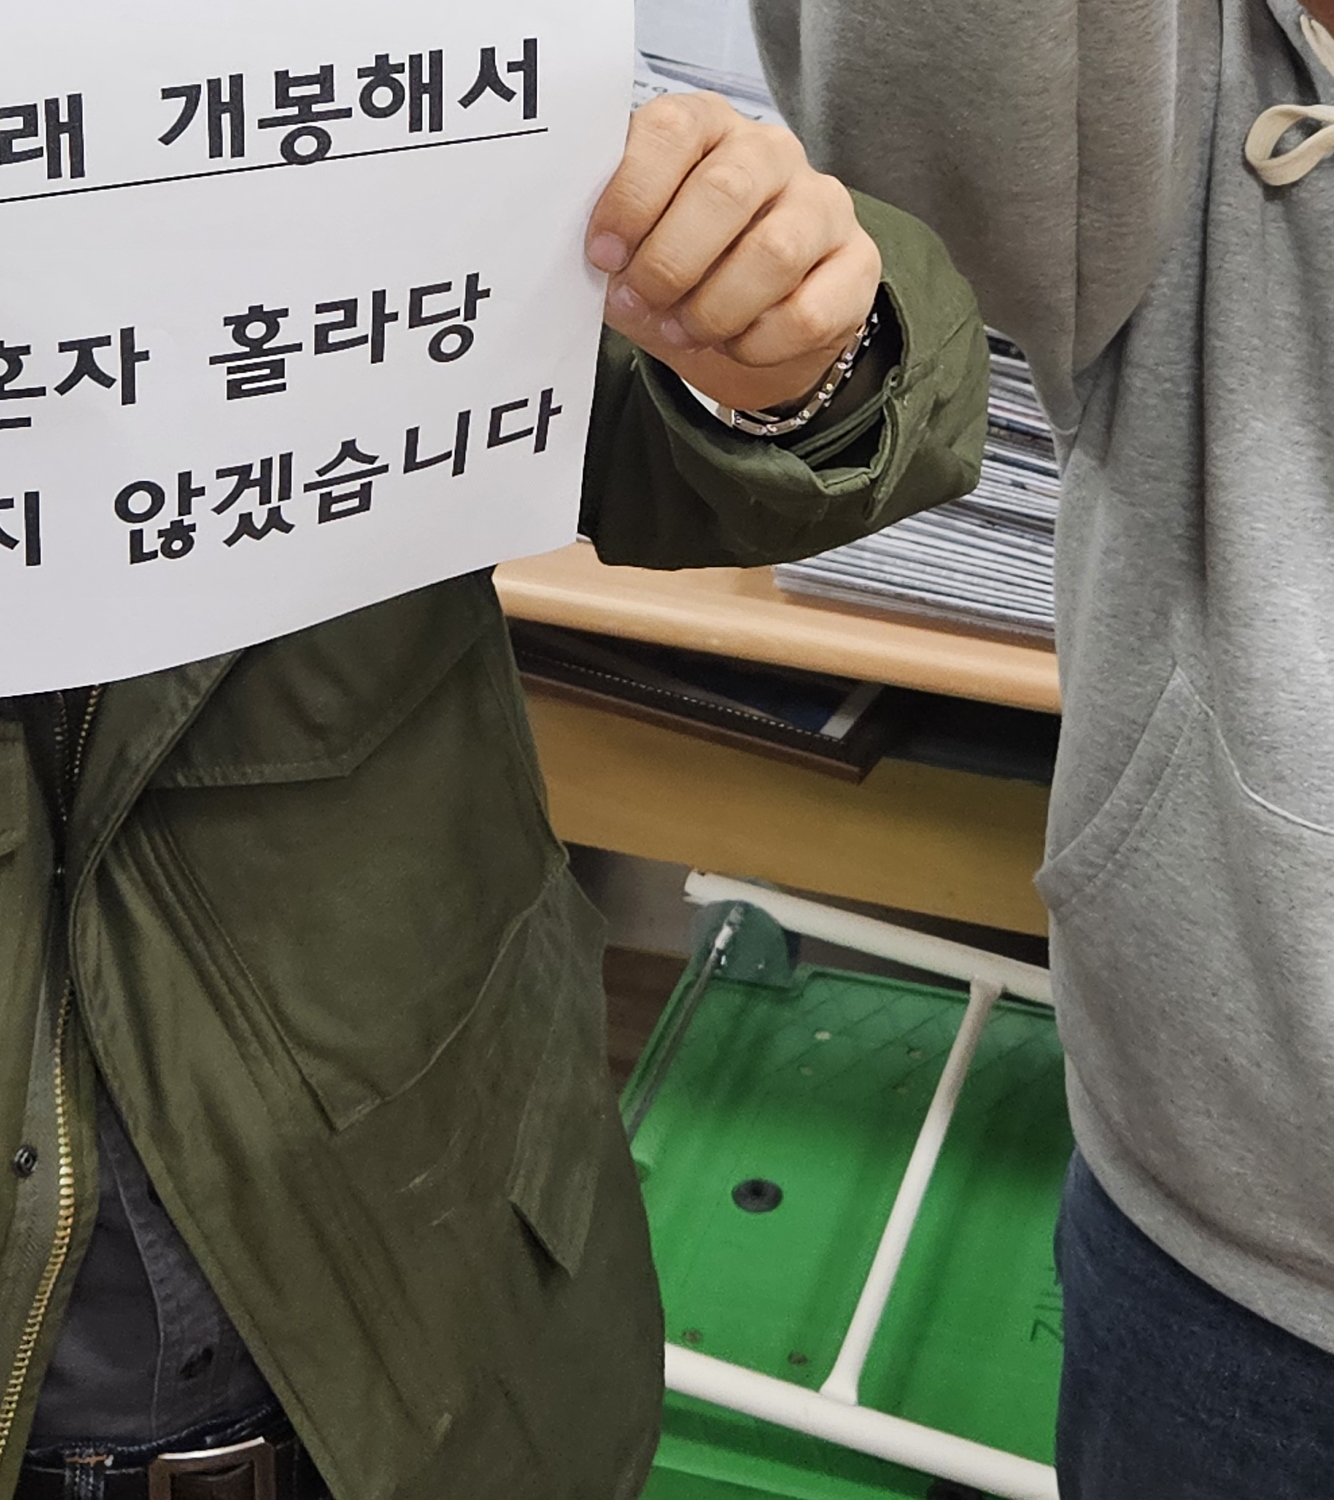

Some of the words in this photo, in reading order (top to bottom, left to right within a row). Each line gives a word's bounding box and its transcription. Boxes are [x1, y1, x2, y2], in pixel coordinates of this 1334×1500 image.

[158, 38, 540, 165] 개봉해서
[209, 273, 490, 400] 홀라당
[114, 387, 562, 565] 않겠습니다
